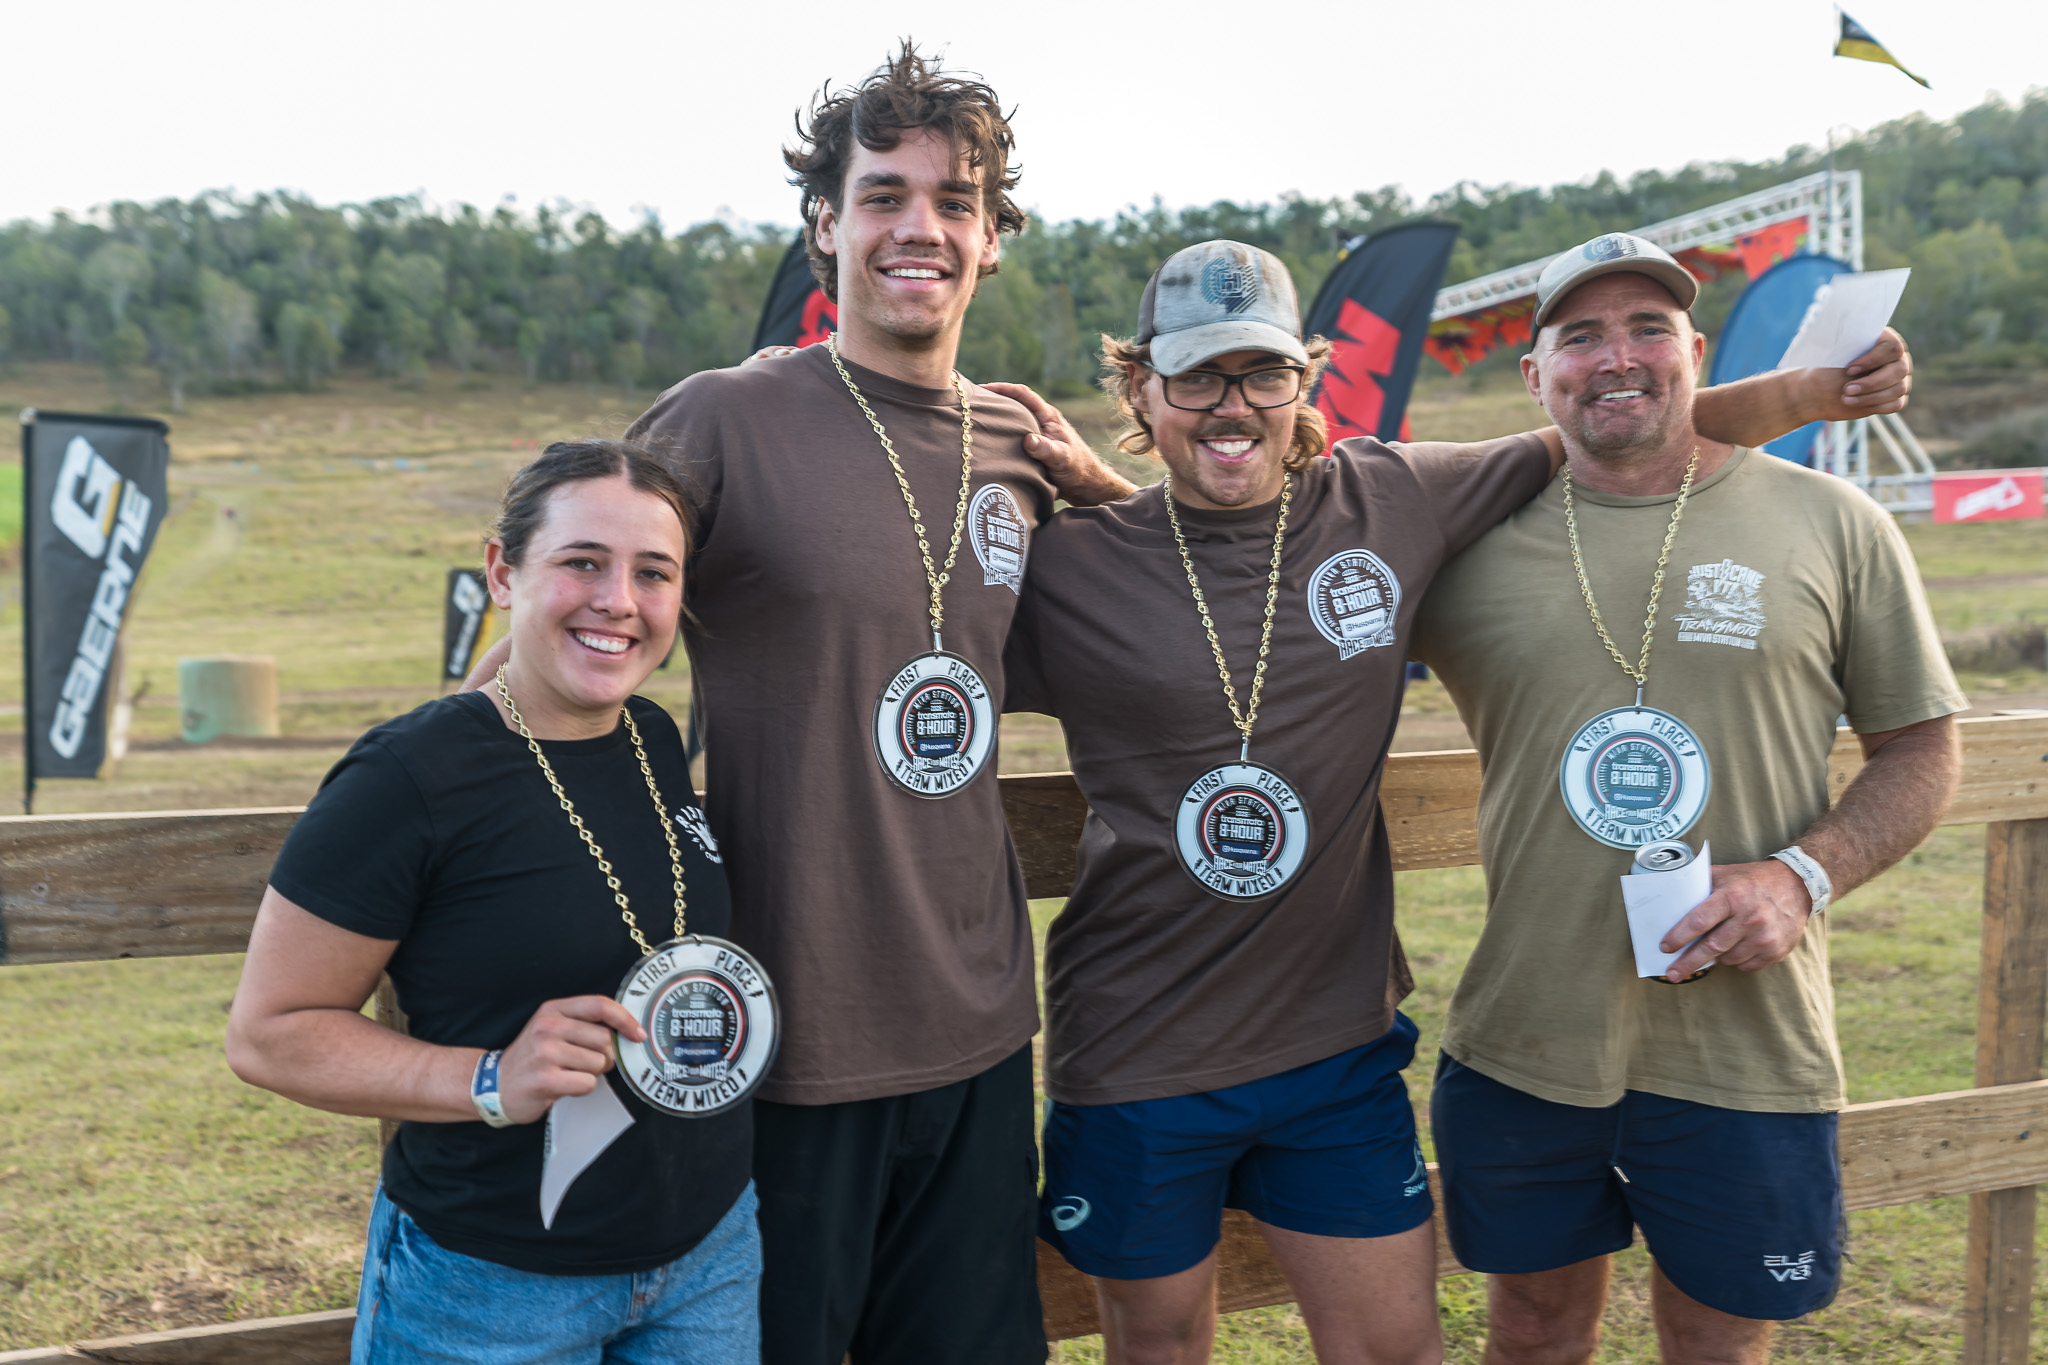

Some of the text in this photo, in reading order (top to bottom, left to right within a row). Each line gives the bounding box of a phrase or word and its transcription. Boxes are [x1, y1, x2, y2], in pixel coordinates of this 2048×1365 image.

[1332, 588, 1383, 615] 8-HOUR
[1340, 638, 1363, 660] RACE
[891, 661, 980, 696] FIRST PLACE
[916, 720, 957, 735] 8-HOUR
[1581, 718, 1690, 751] FIRST PLACE
[901, 764, 969, 791] TEAM MIXED
[1192, 771, 1293, 806] FIRST PLACE
[1610, 772, 1659, 787] 8-HOUR
[1219, 824, 1265, 840] 8-HOUR
[1591, 813, 1674, 843] TEAM MIXED
[1200, 865, 1275, 894] TEAM MIXED
[639, 951, 757, 990] FIRST PLACE
[670, 1020, 723, 1037] 8-HOUR
[648, 1075, 739, 1108] TEAM MIXED
[1763, 1250, 1816, 1266] ELE
